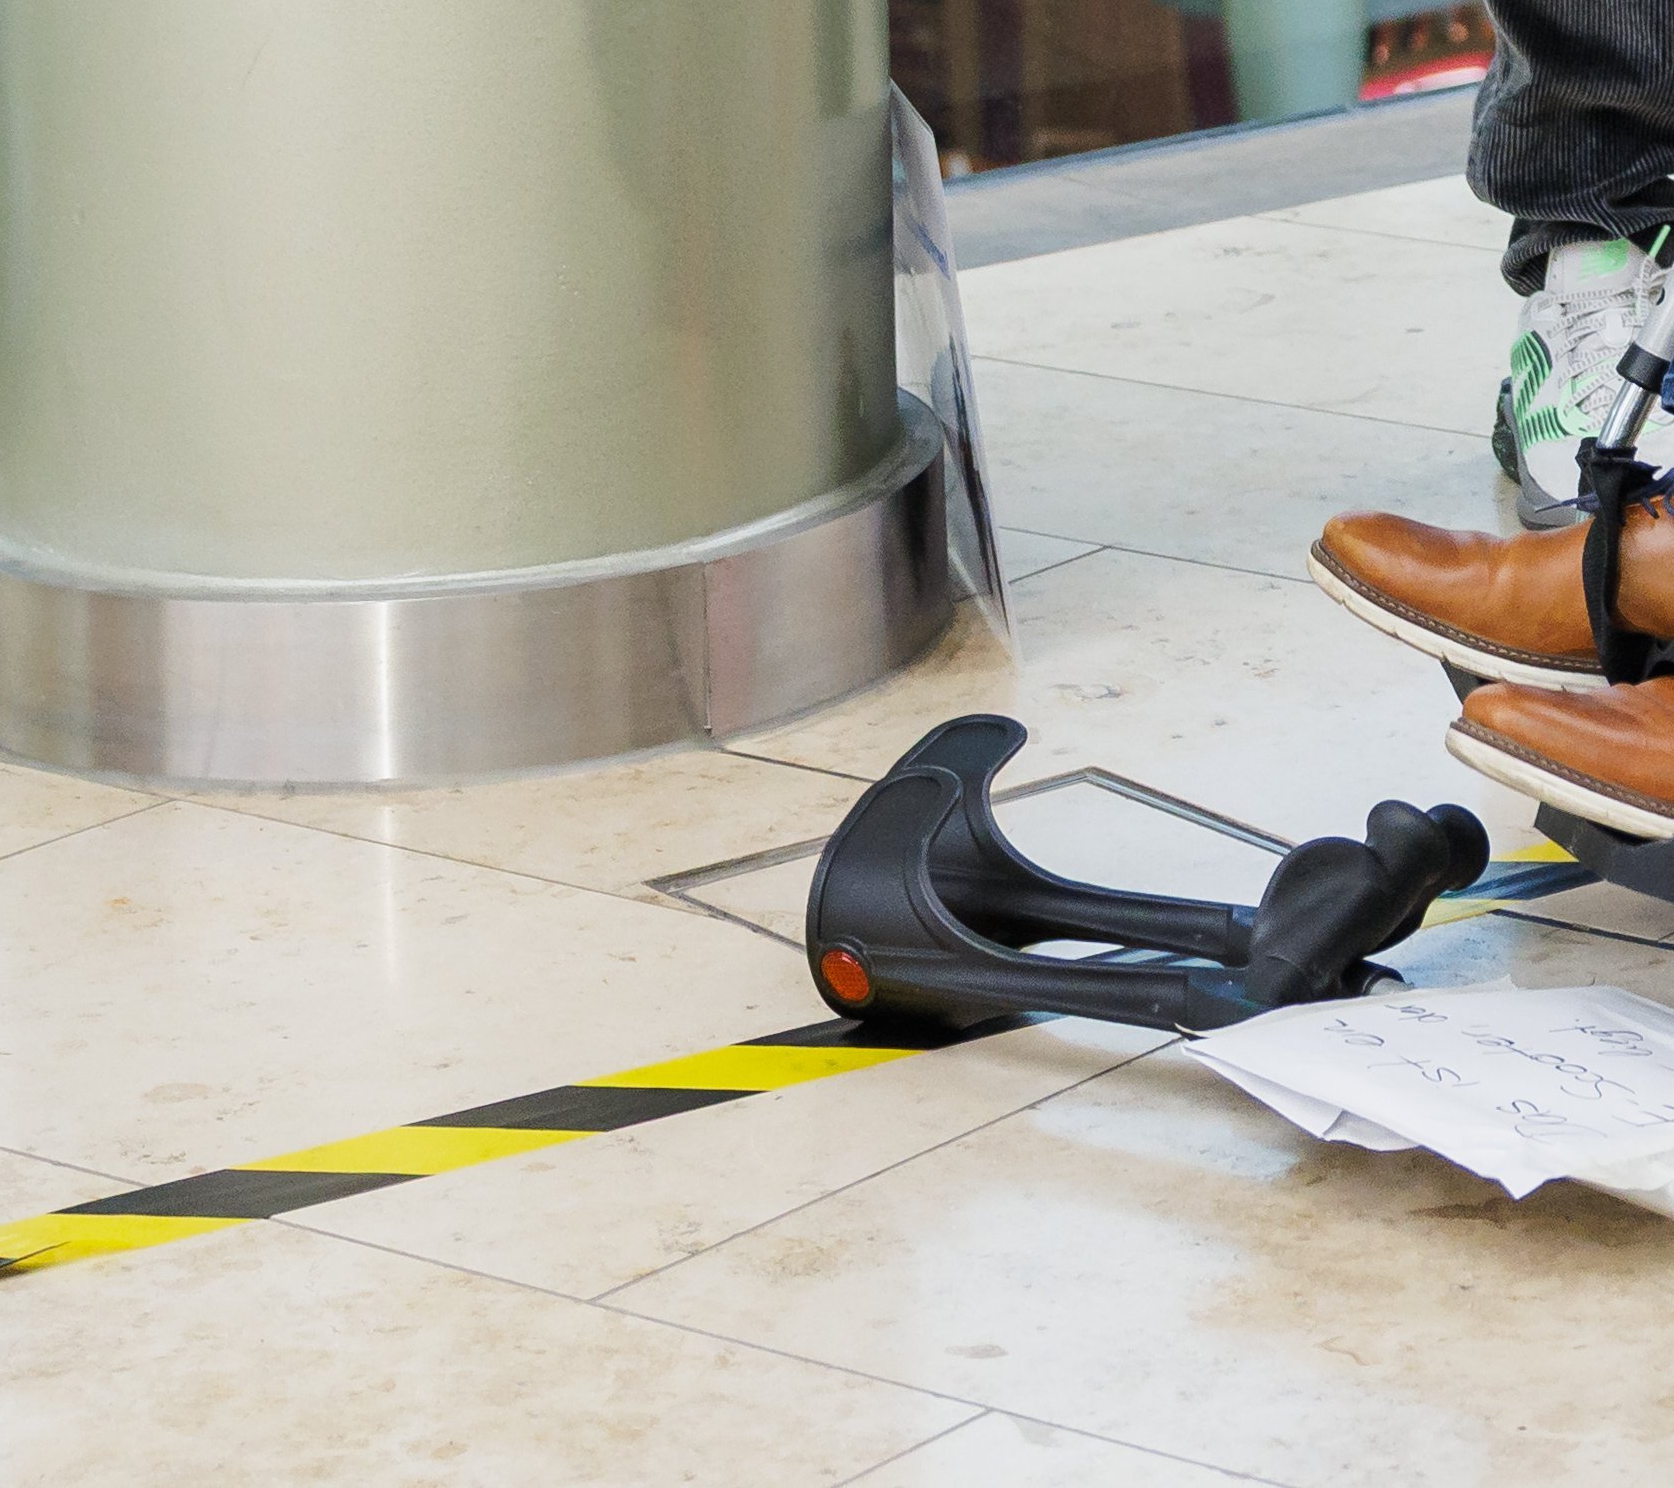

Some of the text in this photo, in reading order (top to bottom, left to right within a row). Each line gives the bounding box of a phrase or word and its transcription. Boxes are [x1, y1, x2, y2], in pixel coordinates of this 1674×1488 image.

[1383, 1003, 1449, 1024] der
[1365, 1054, 1482, 1088] ist
[1493, 1098, 1609, 1145] Das
